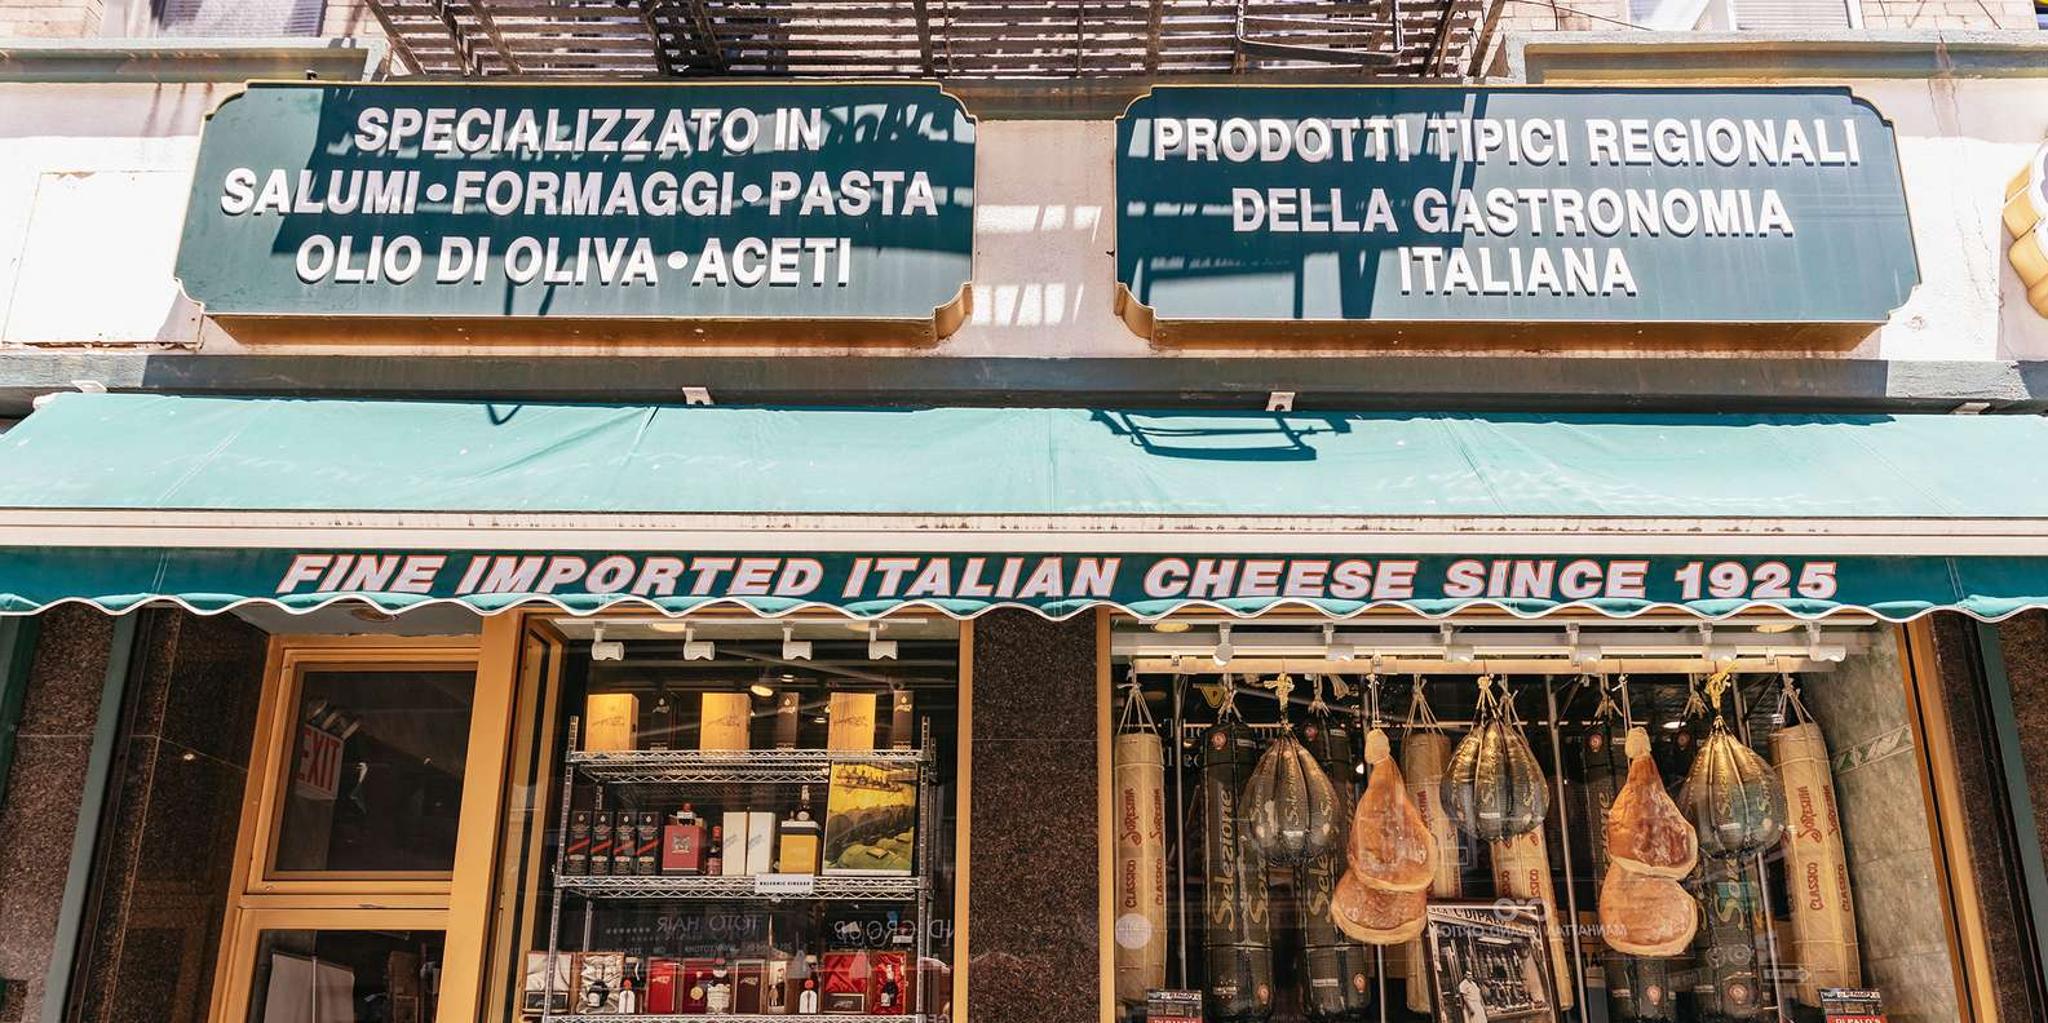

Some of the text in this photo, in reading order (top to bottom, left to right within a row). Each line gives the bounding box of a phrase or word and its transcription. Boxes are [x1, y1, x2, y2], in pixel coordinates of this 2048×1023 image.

[356, 107, 823, 153] SPECIALIZZATO IN
[1152, 118, 1861, 167] PRODOTTI TIPICI REGIONALI
[220, 170, 938, 218] SALUMI FORMAGGI PASTA
[1232, 188, 1793, 238] DELLA GASTRONOMIA
[295, 236, 852, 289] OLIO DI OLIVA ACETI
[1399, 246, 1638, 296] ITALIANA
[278, 554, 1838, 601] FINE IMPORTED ITALIAN CHEESE SINCE 1925
[298, 727, 339, 791] EXIT
[1212, 789, 1235, 932] Selezione
[1806, 861, 1824, 911] CLASSICO
